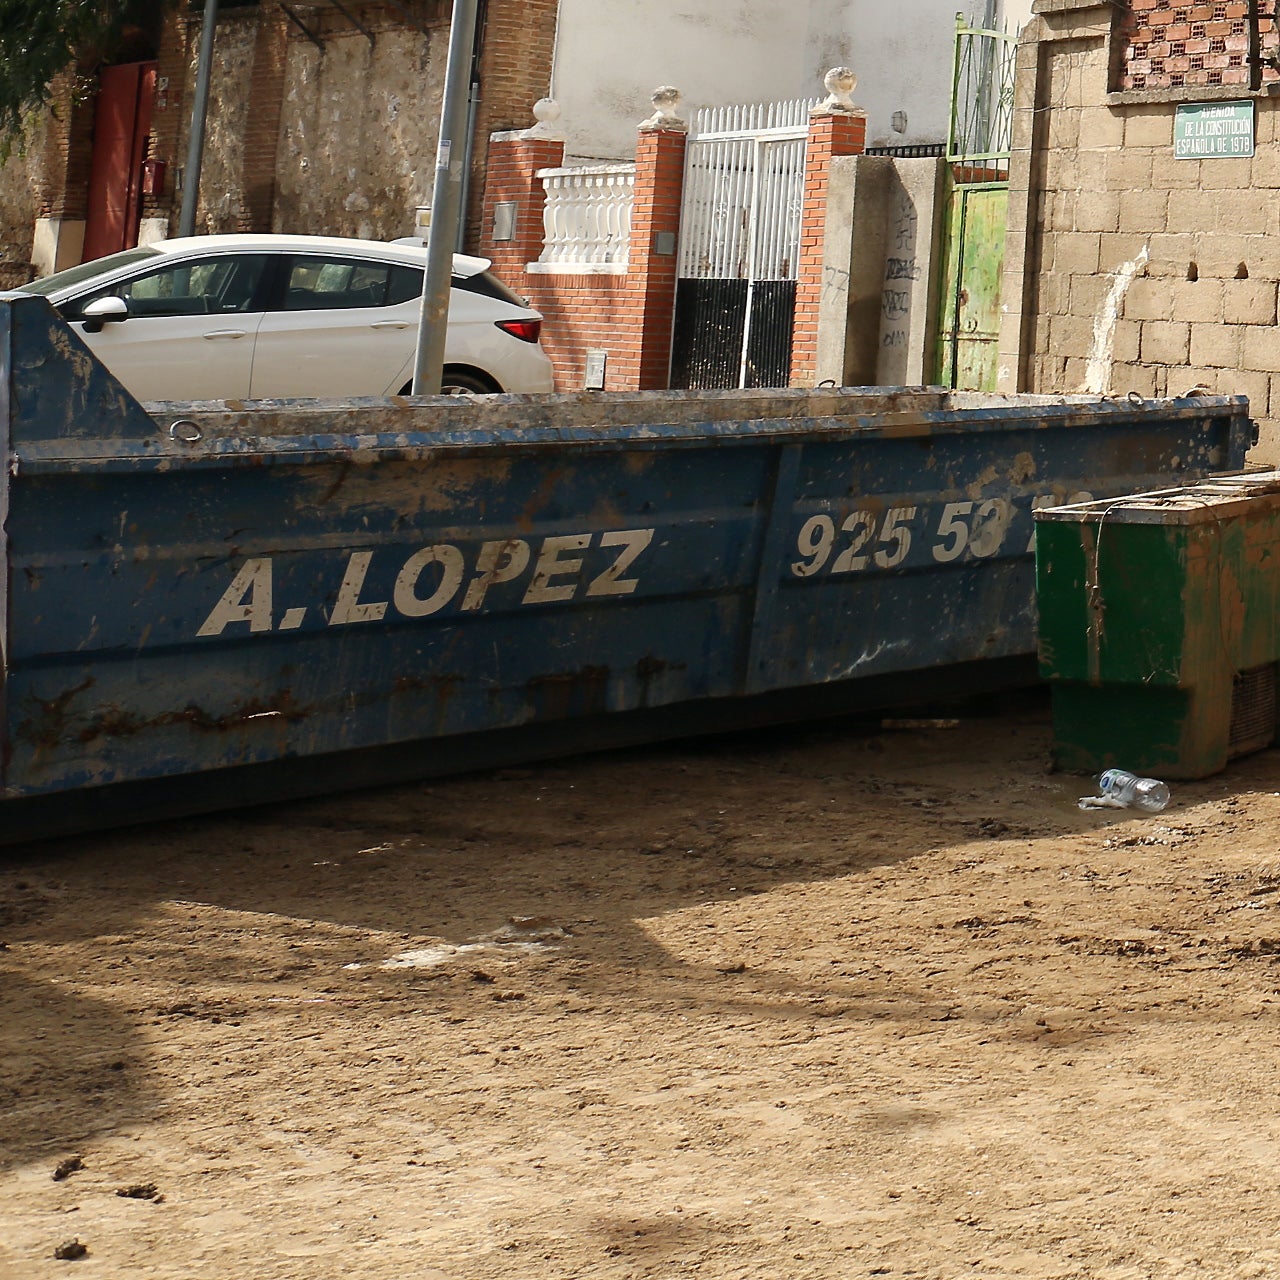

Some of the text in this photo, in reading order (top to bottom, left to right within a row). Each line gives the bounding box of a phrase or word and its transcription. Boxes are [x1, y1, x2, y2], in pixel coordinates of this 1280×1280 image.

[1201, 106, 1235, 118] AVENIDA
[1185, 117, 1250, 136] DE LA CONSTITUCIÓN
[1217, 137, 1227, 153] DE
[1231, 136, 1250, 153] 1978
[791, 506, 918, 577] 925
[195, 528, 656, 637] A. LOPEZ
